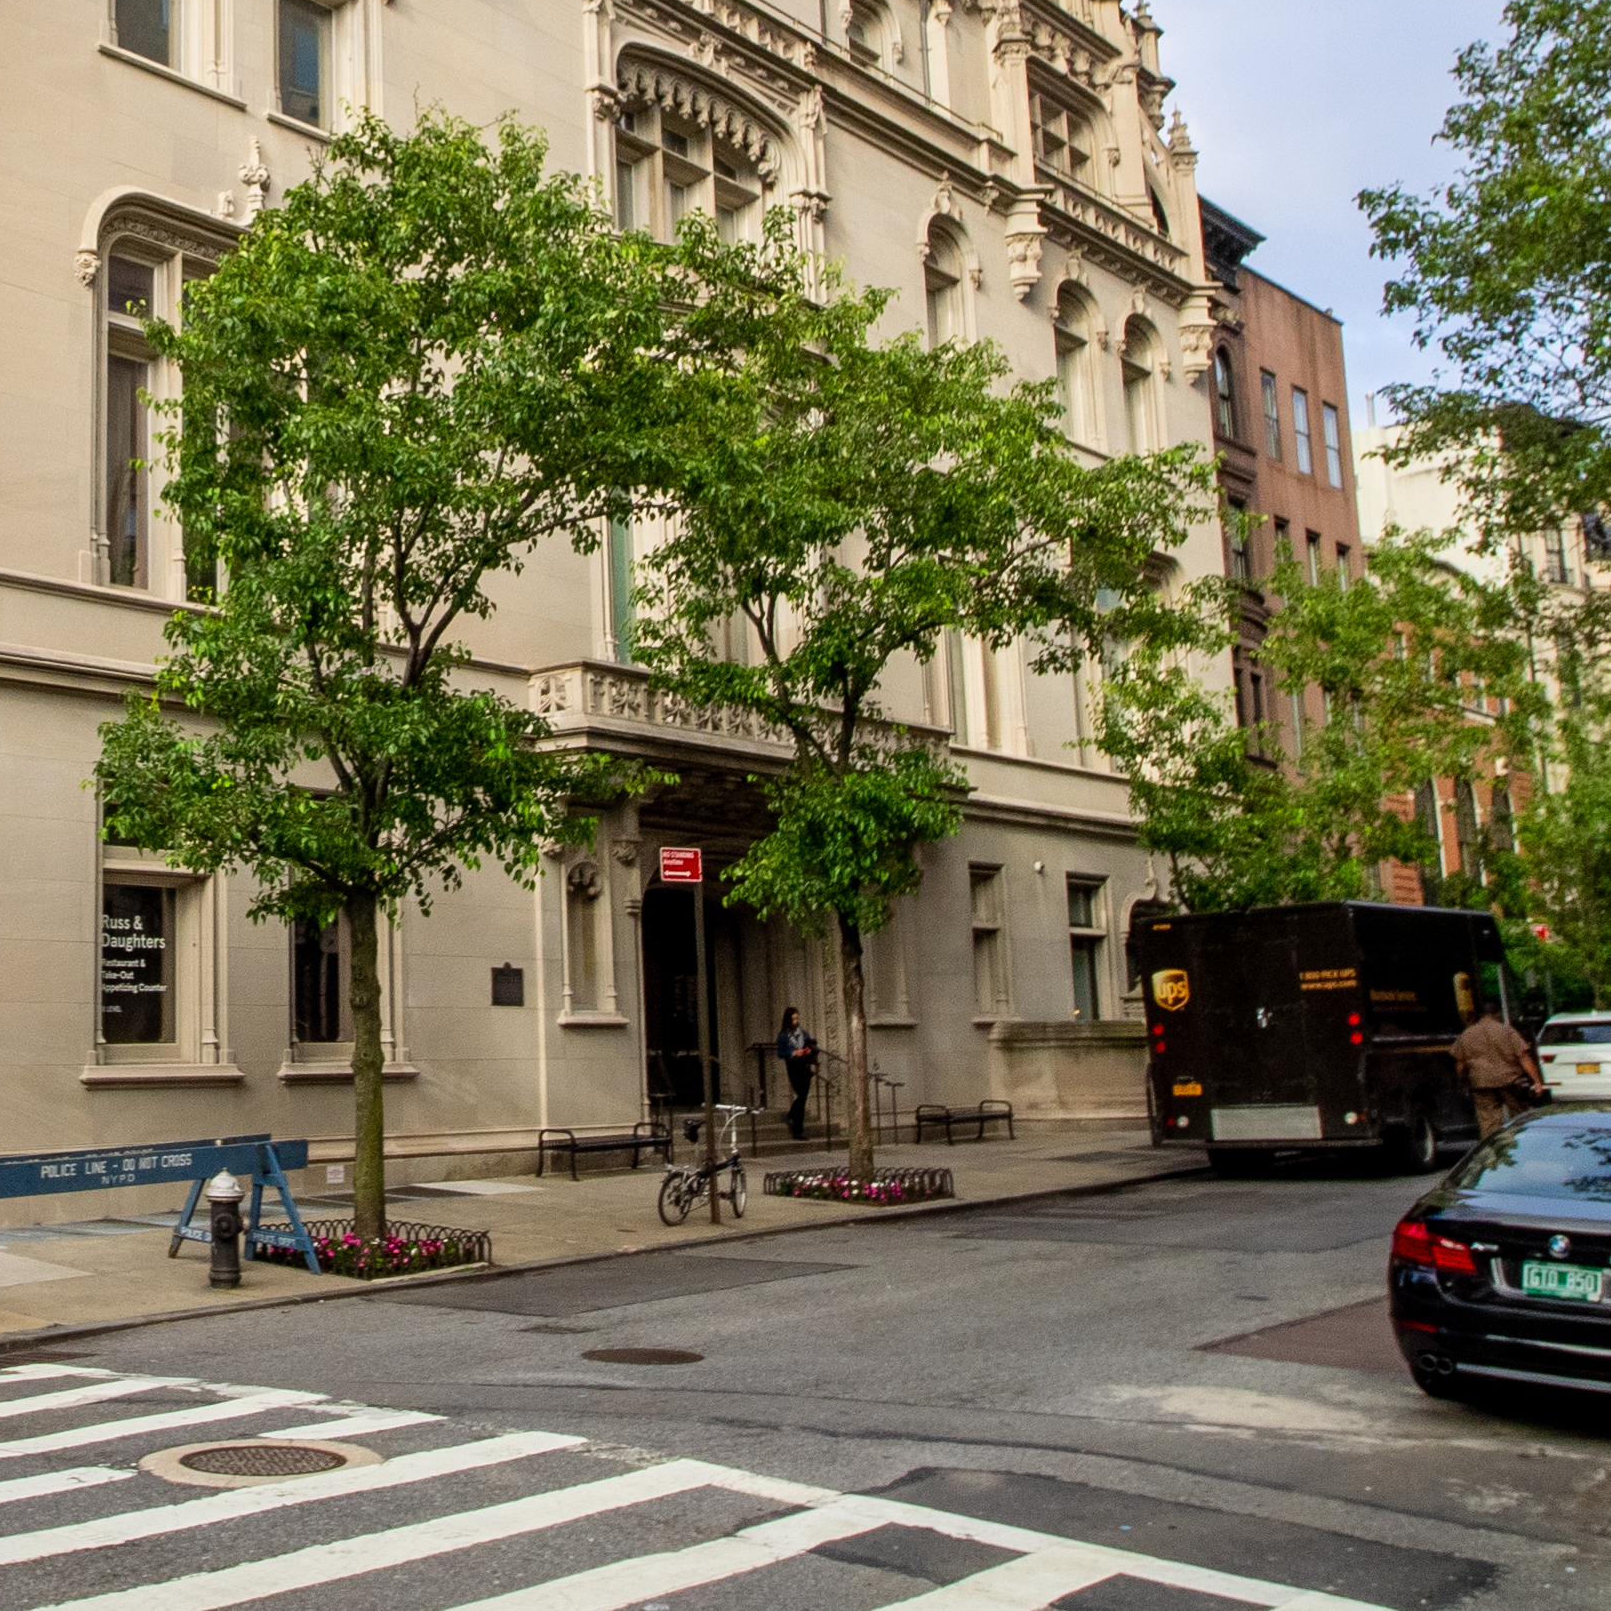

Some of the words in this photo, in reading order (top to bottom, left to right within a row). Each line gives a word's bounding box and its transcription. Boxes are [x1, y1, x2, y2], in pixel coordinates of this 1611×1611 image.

[102, 914, 131, 930] Russ
[133, 915, 144, 930] &
[101, 932, 166, 952] Daughters
[41, 1163, 78, 1179] POLICE
[85, 1160, 108, 1175] LINE
[123, 1158, 136, 1172] DO
[138, 1156, 158, 1171] NOT
[161, 1153, 193, 1169] CROSS
[101, 1174, 136, 1185] NYPD
